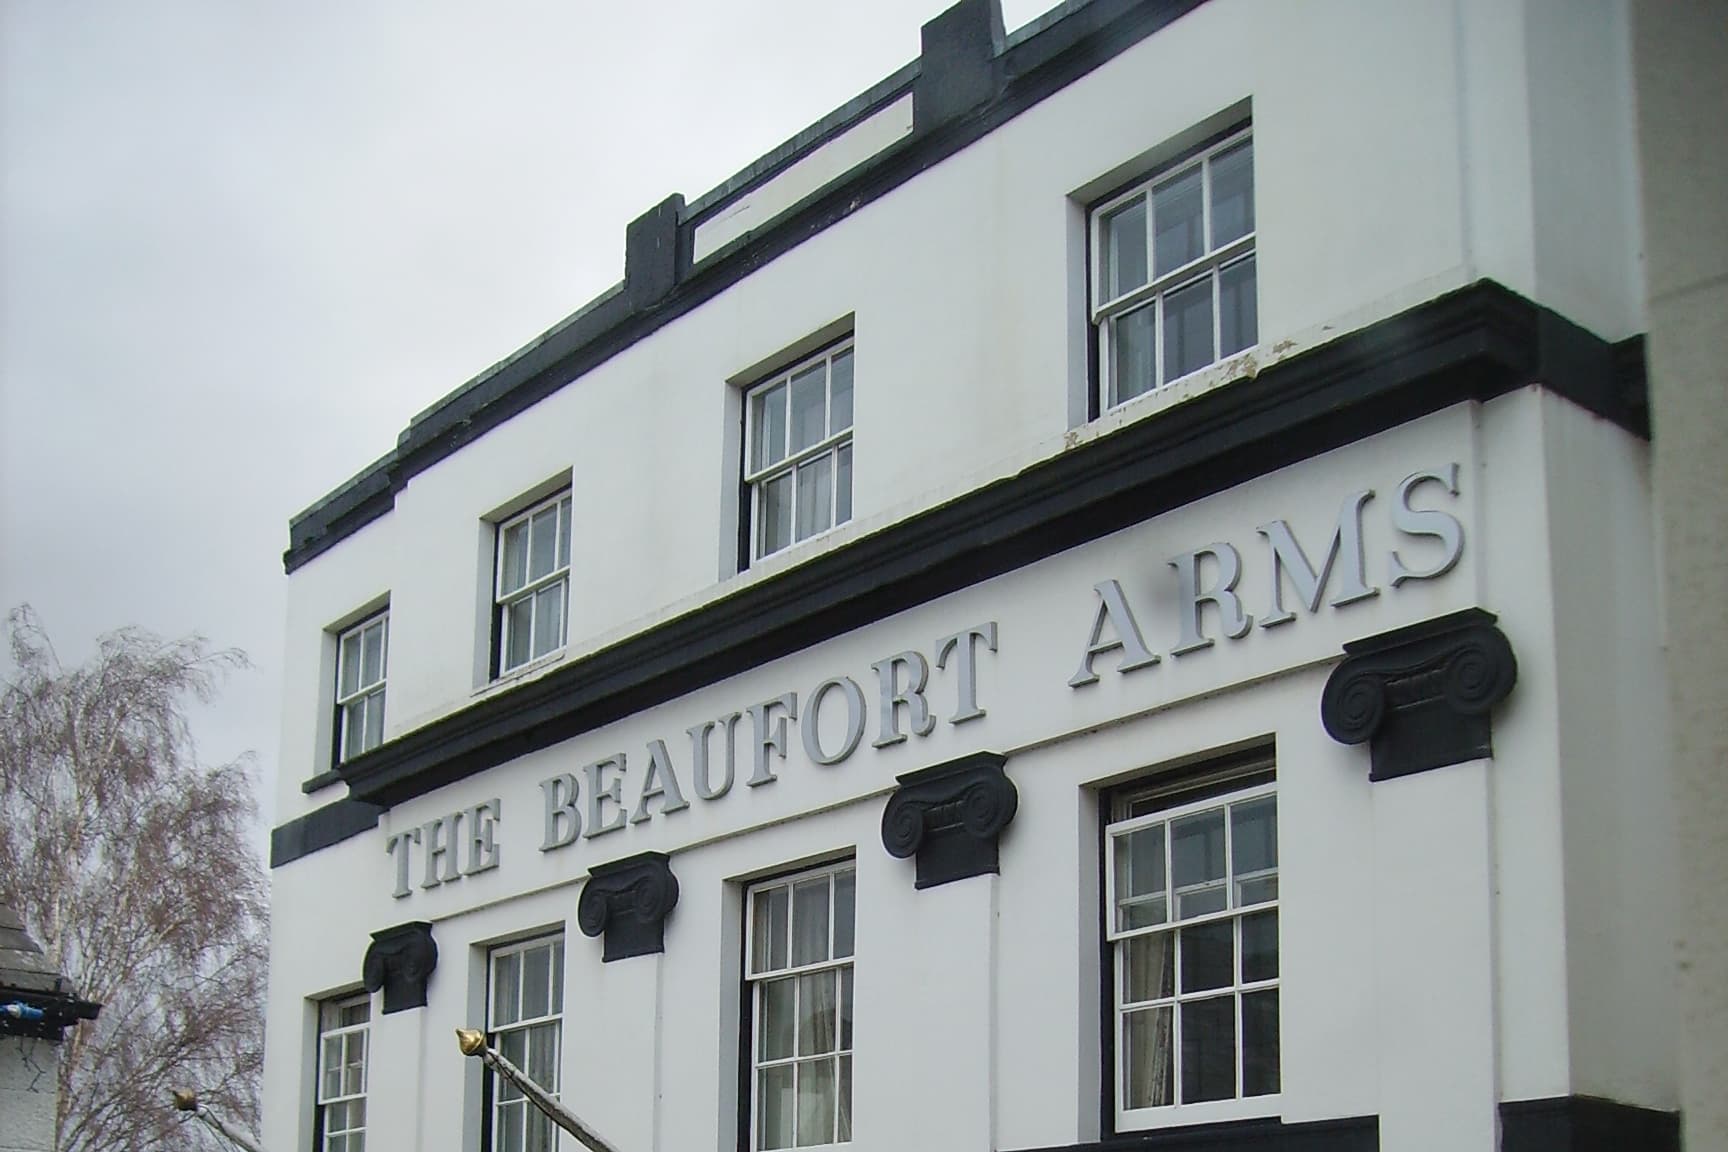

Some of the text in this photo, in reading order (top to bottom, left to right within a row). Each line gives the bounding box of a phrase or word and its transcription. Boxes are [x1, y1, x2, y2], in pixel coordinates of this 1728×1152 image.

[385, 461, 1466, 899] THE BEAUFORT ARMS
